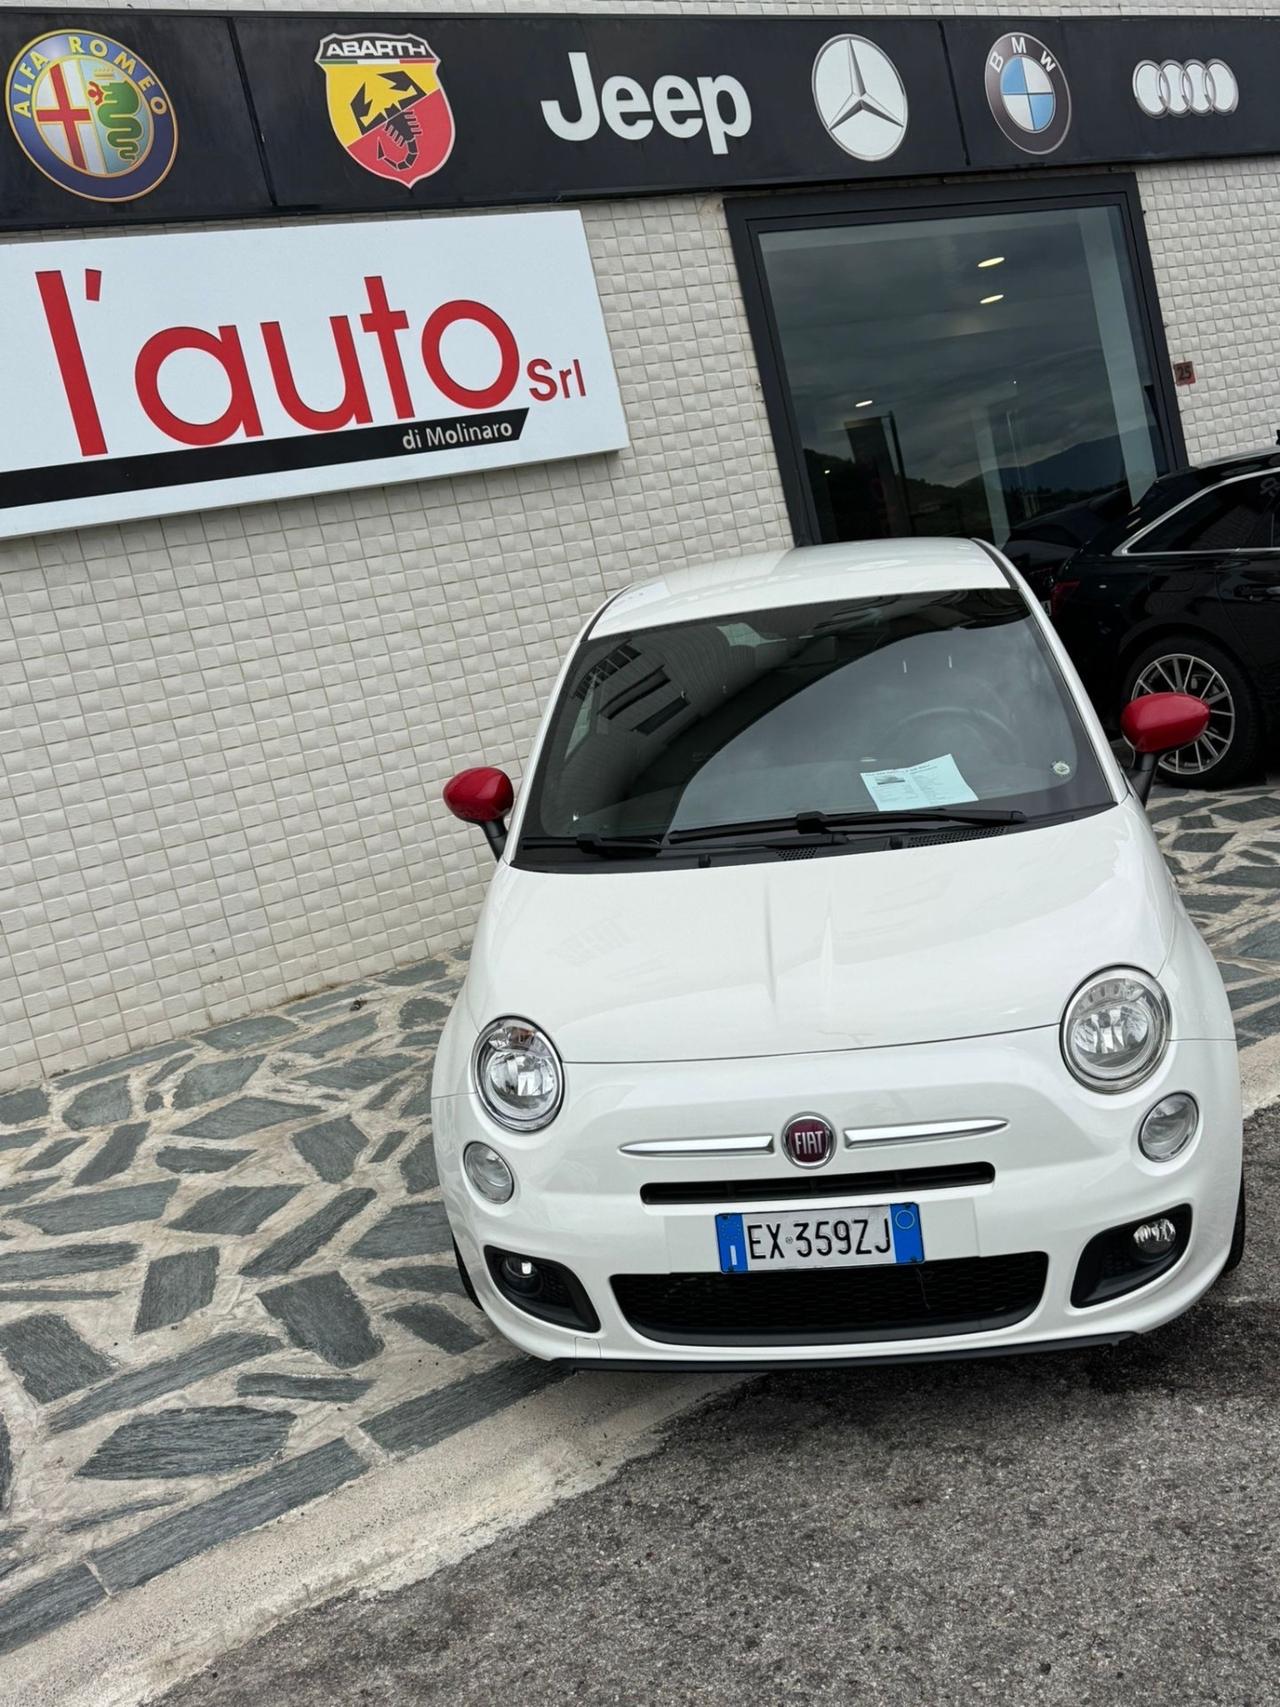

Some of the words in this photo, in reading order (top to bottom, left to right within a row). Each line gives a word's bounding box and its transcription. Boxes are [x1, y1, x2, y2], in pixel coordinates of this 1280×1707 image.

[327, 40, 426, 56] ABARTH
[989, 36, 1056, 73] BMW
[13, 50, 49, 118] ALFA
[68, 36, 168, 115] ROMEO
[541, 52, 752, 155] Jeep
[35, 269, 520, 457] l'auto
[527, 359, 586, 401] Srl
[1177, 366, 1192, 381] 25
[402, 430, 422, 450] di
[426, 421, 513, 446] Molinaro
[794, 1130, 824, 1155] FIAT
[747, 1223, 785, 1260] EX
[793, 1218, 891, 1257] 359ZJ
